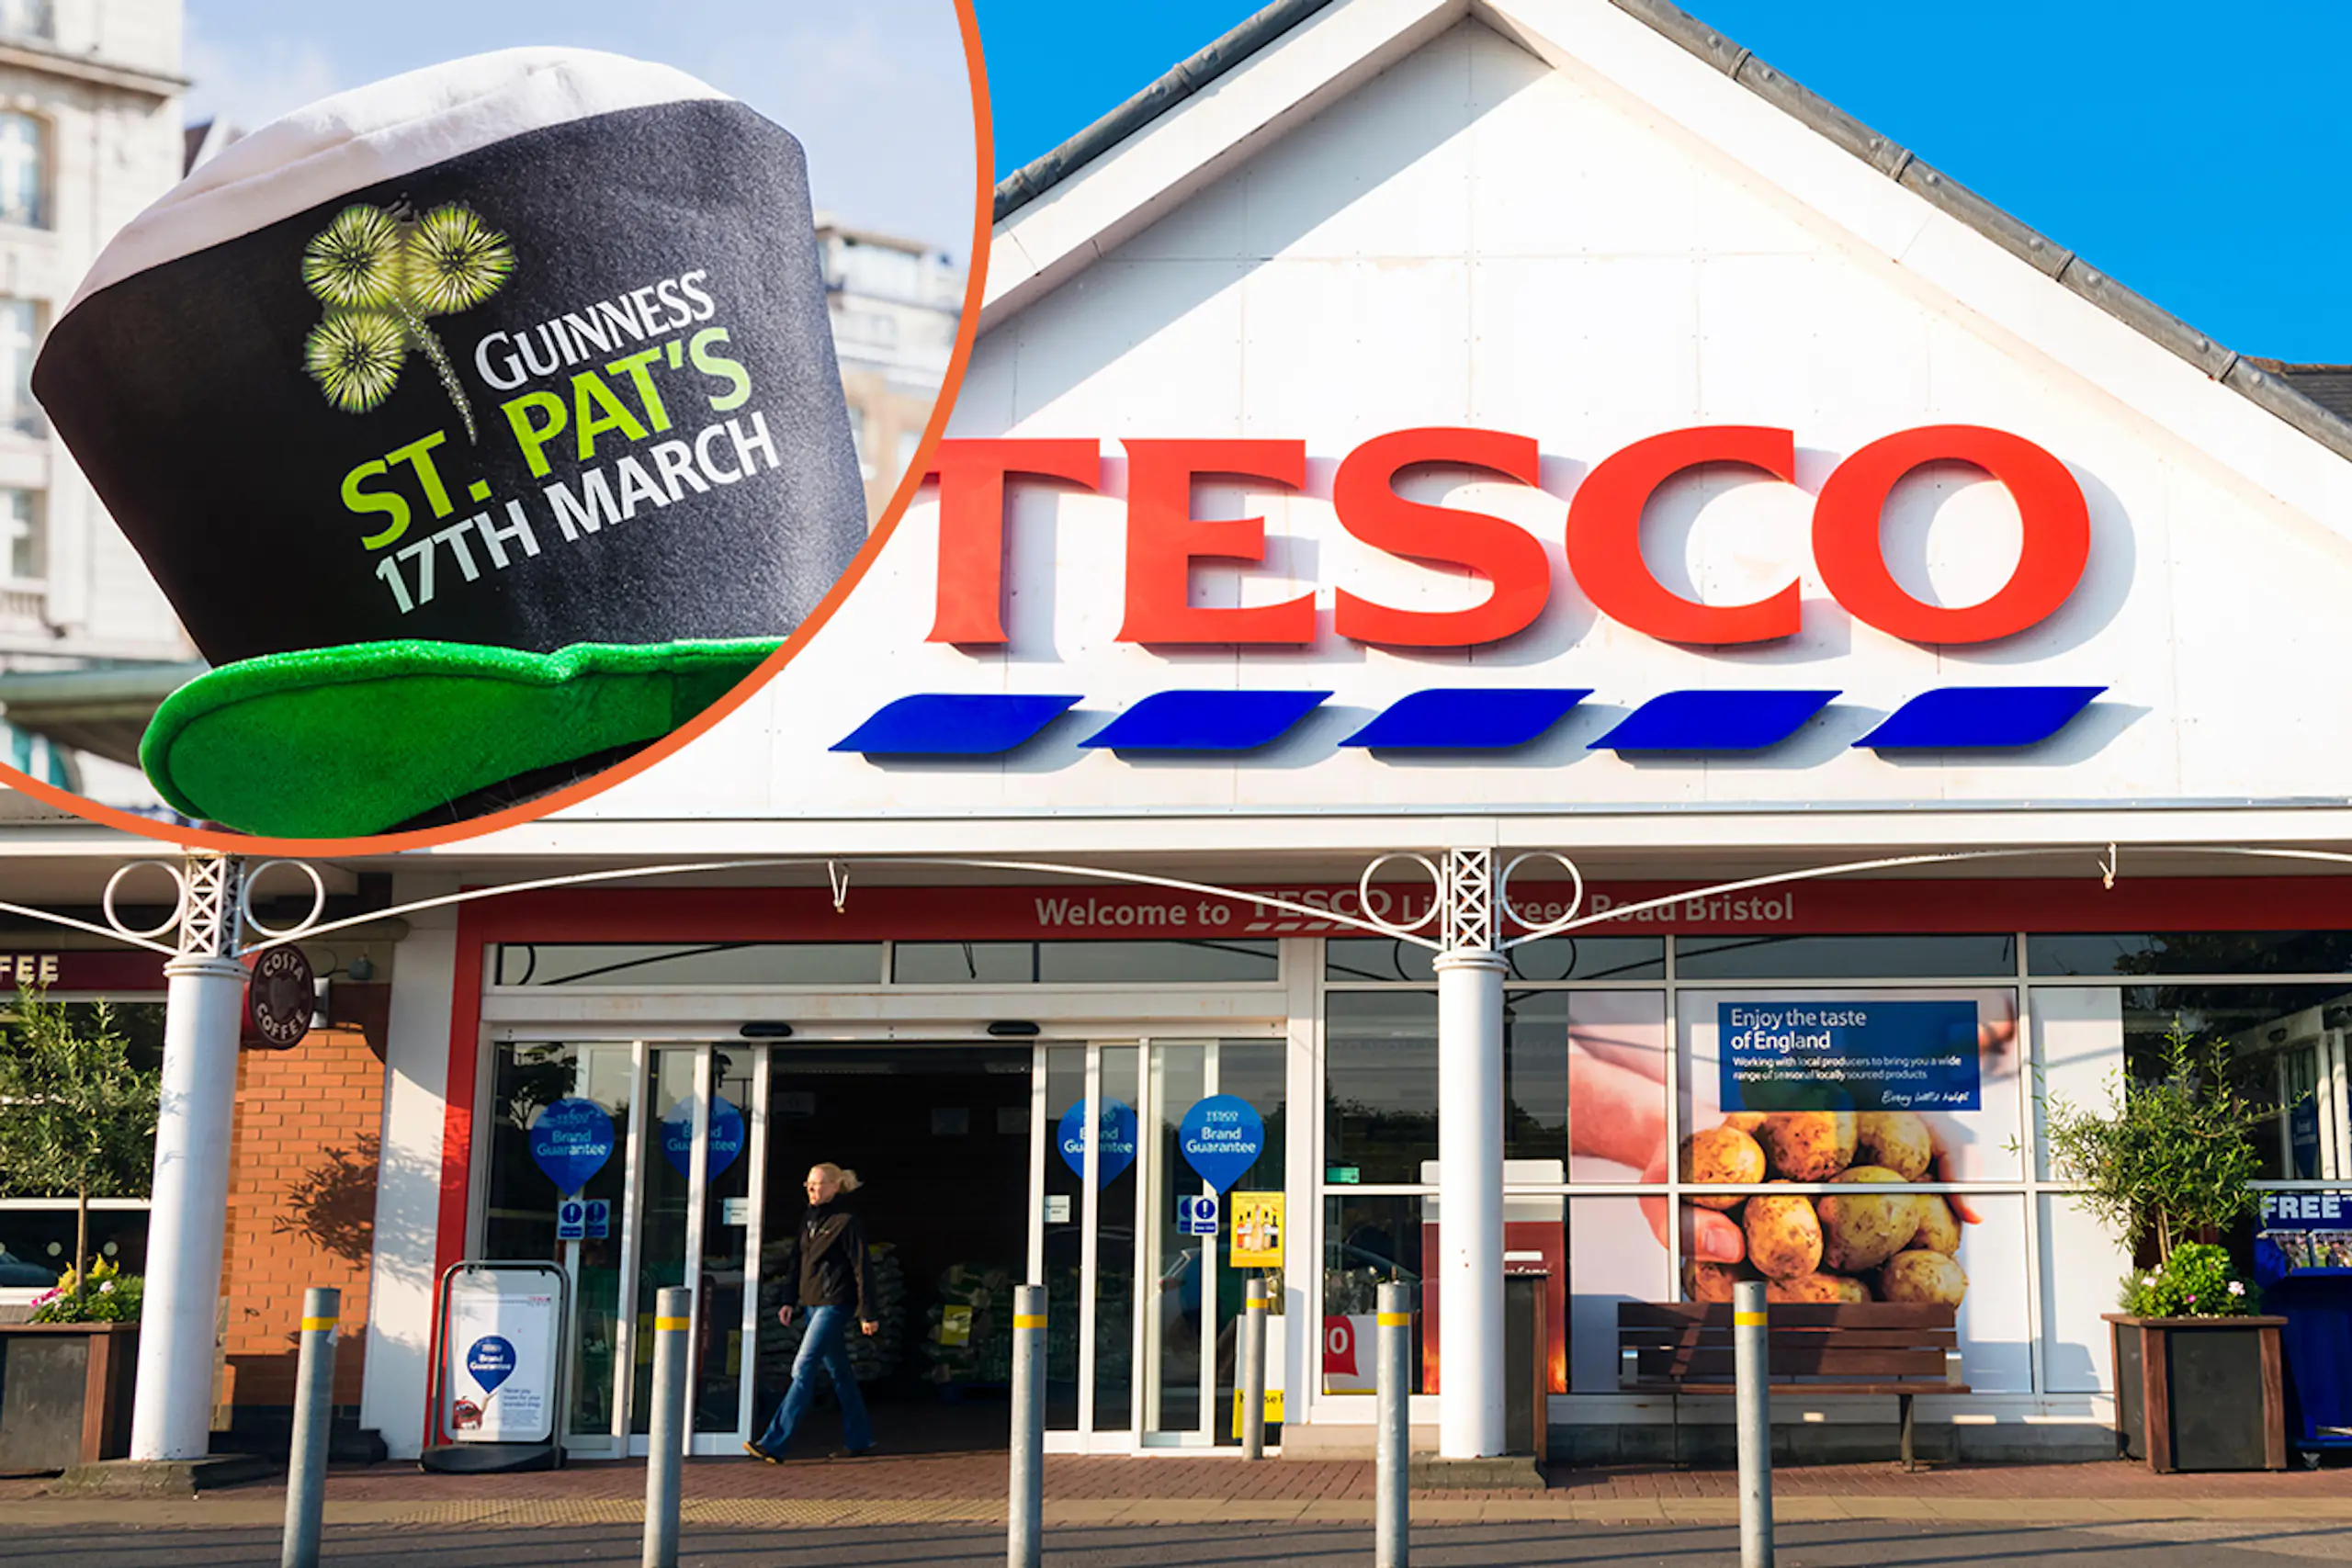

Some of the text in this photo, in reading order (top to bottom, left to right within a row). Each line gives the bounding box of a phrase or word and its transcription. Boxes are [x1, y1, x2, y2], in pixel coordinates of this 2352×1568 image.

[474, 270, 715, 391] GUINNESS
[340, 326, 752, 551] ST. PAT'S
[375, 412, 782, 615] 17TH MARCH
[922, 423, 2092, 648] TESCO
[1035, 897, 1187, 926] Welcome
[1196, 900, 1231, 926] to
[1250, 889, 1393, 919] TESCO
[1590, 894, 1677, 922] Road
[1686, 892, 1793, 922] Bristol
[262, 953, 304, 982] COSTA
[256, 1002, 307, 1041] COFFEE
[1731, 1008, 1867, 1031] Enjoy the taste
[1730, 1030, 1831, 1054] of England
[1732, 1055, 1774, 1068] Working
[1775, 1055, 1797, 1067] with
[1798, 1055, 1821, 1067] local
[1822, 1056, 1871, 1068] producers
[1871, 1057, 1883, 1066] to
[1883, 1055, 1909, 1068] bring
[1910, 1057, 1929, 1068] you
[1939, 1055, 1962, 1066] wide
[1816, 1069, 1846, 1082] locally
[1846, 1069, 1884, 1080] sourced
[1885, 1069, 1928, 1081] products
[552, 1129, 592, 1144] Brand
[683, 1124, 723, 1139] Bnd
[1080, 1126, 1119, 1141] Bnd
[1201, 1126, 1242, 1140] Brand
[537, 1142, 607, 1156] Guarantee
[1185, 1138, 1257, 1154] Guarantee
